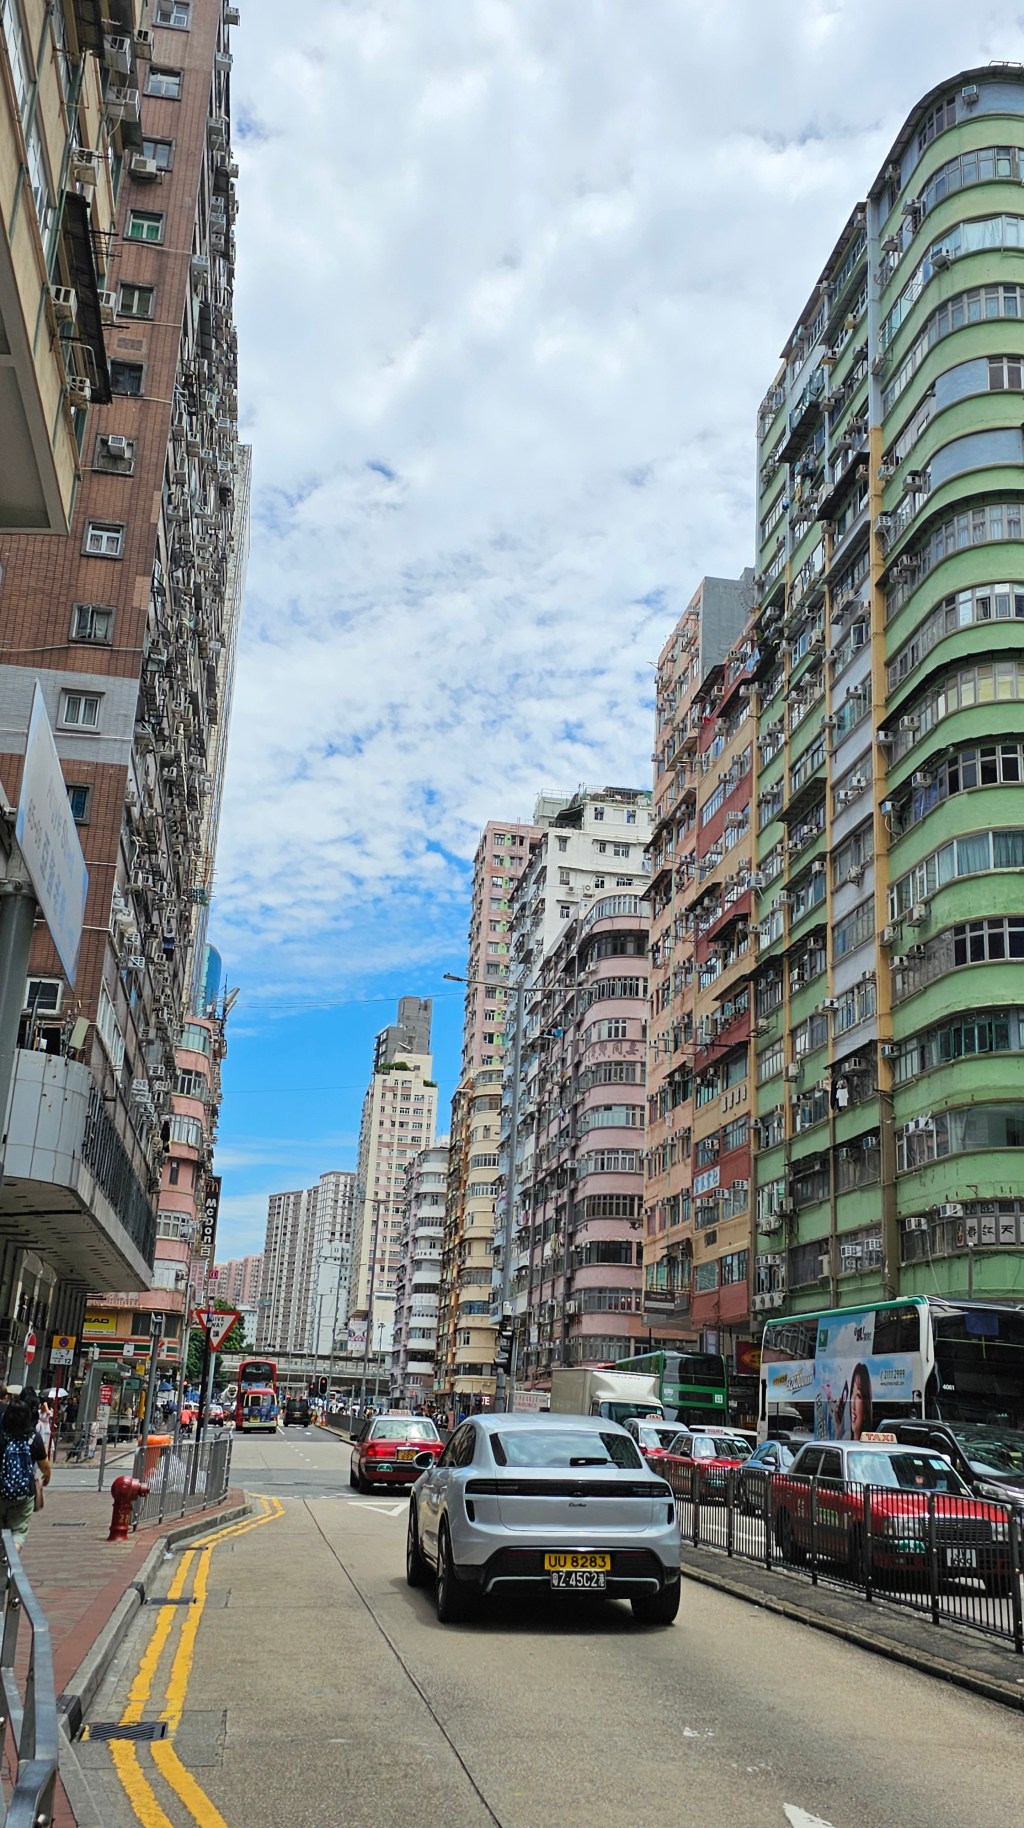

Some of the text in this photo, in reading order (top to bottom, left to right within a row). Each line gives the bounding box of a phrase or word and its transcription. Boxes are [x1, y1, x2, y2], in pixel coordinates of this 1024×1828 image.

[866, 1434, 895, 1442] TAXI
[548, 1555, 607, 1568] UU 8283
